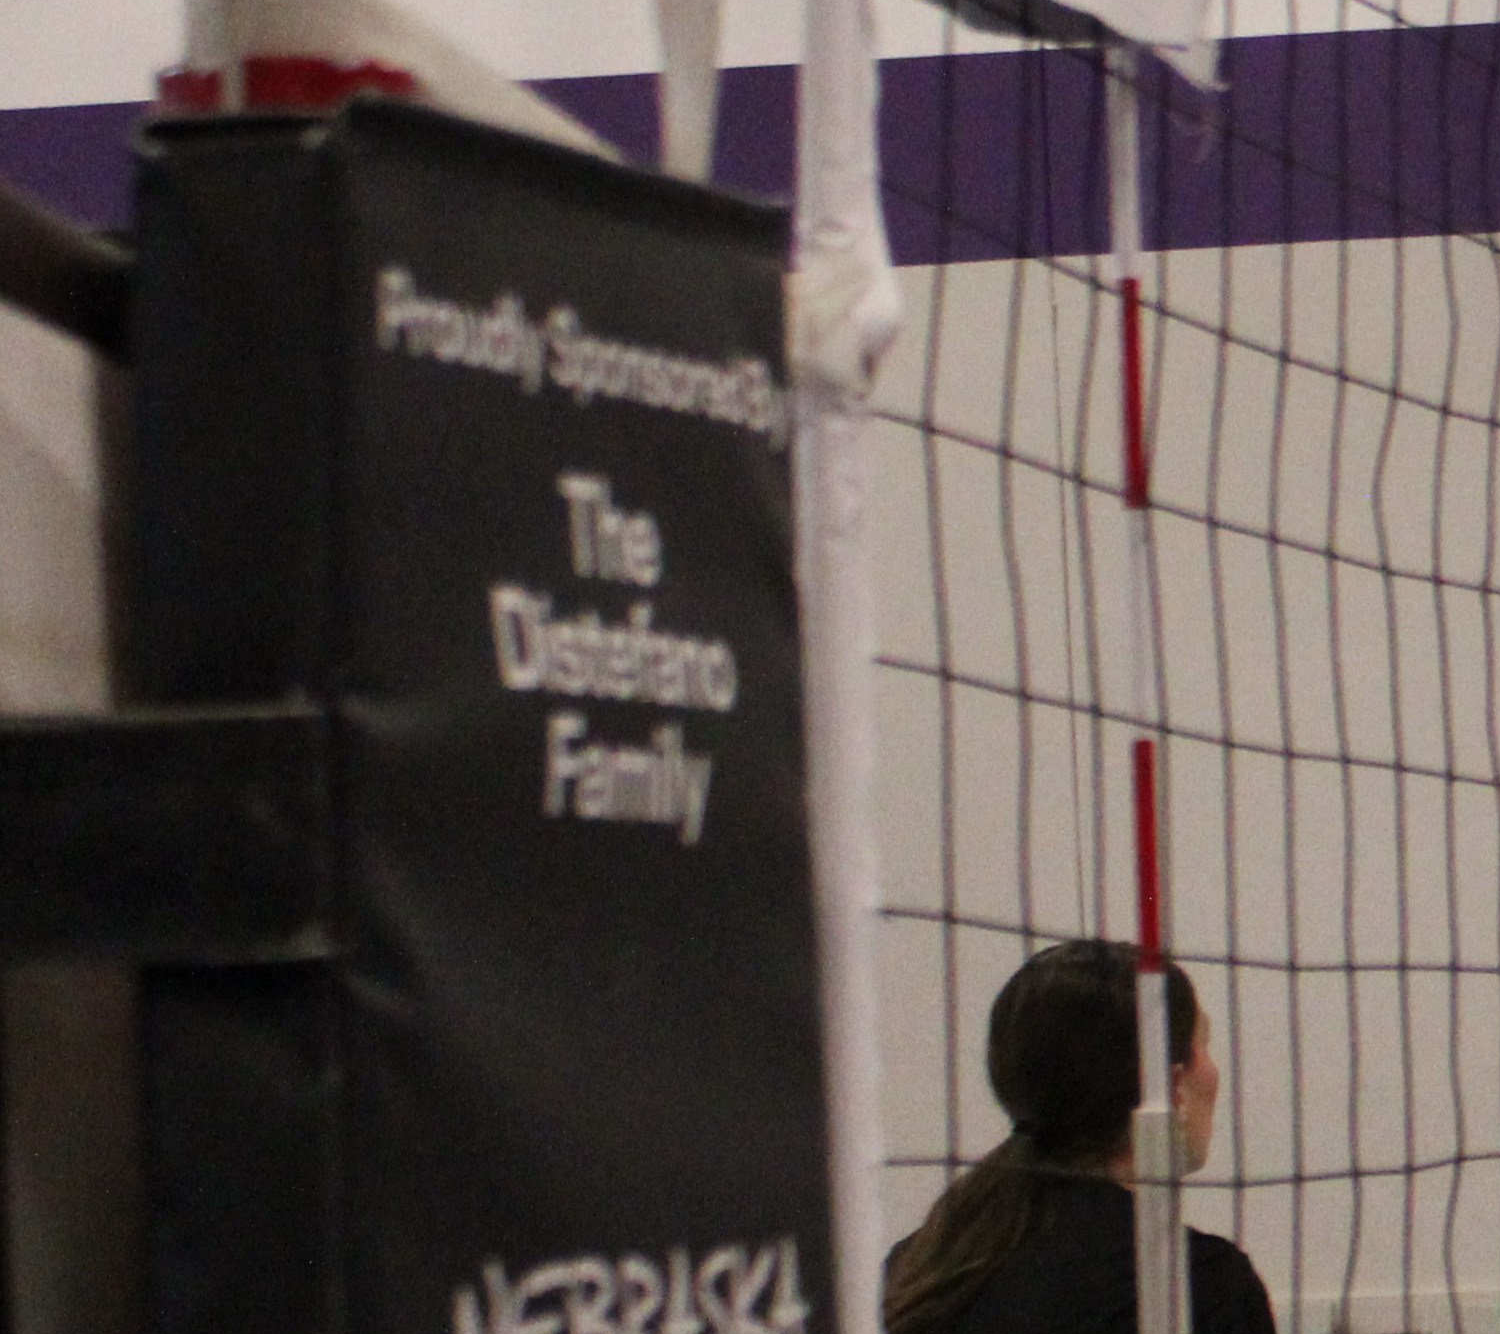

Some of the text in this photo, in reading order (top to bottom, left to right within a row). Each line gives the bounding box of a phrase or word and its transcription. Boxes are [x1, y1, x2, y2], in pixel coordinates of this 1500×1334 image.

[376, 263, 542, 395] Proudly
[558, 473, 664, 586] The
[543, 710, 714, 846] Family
